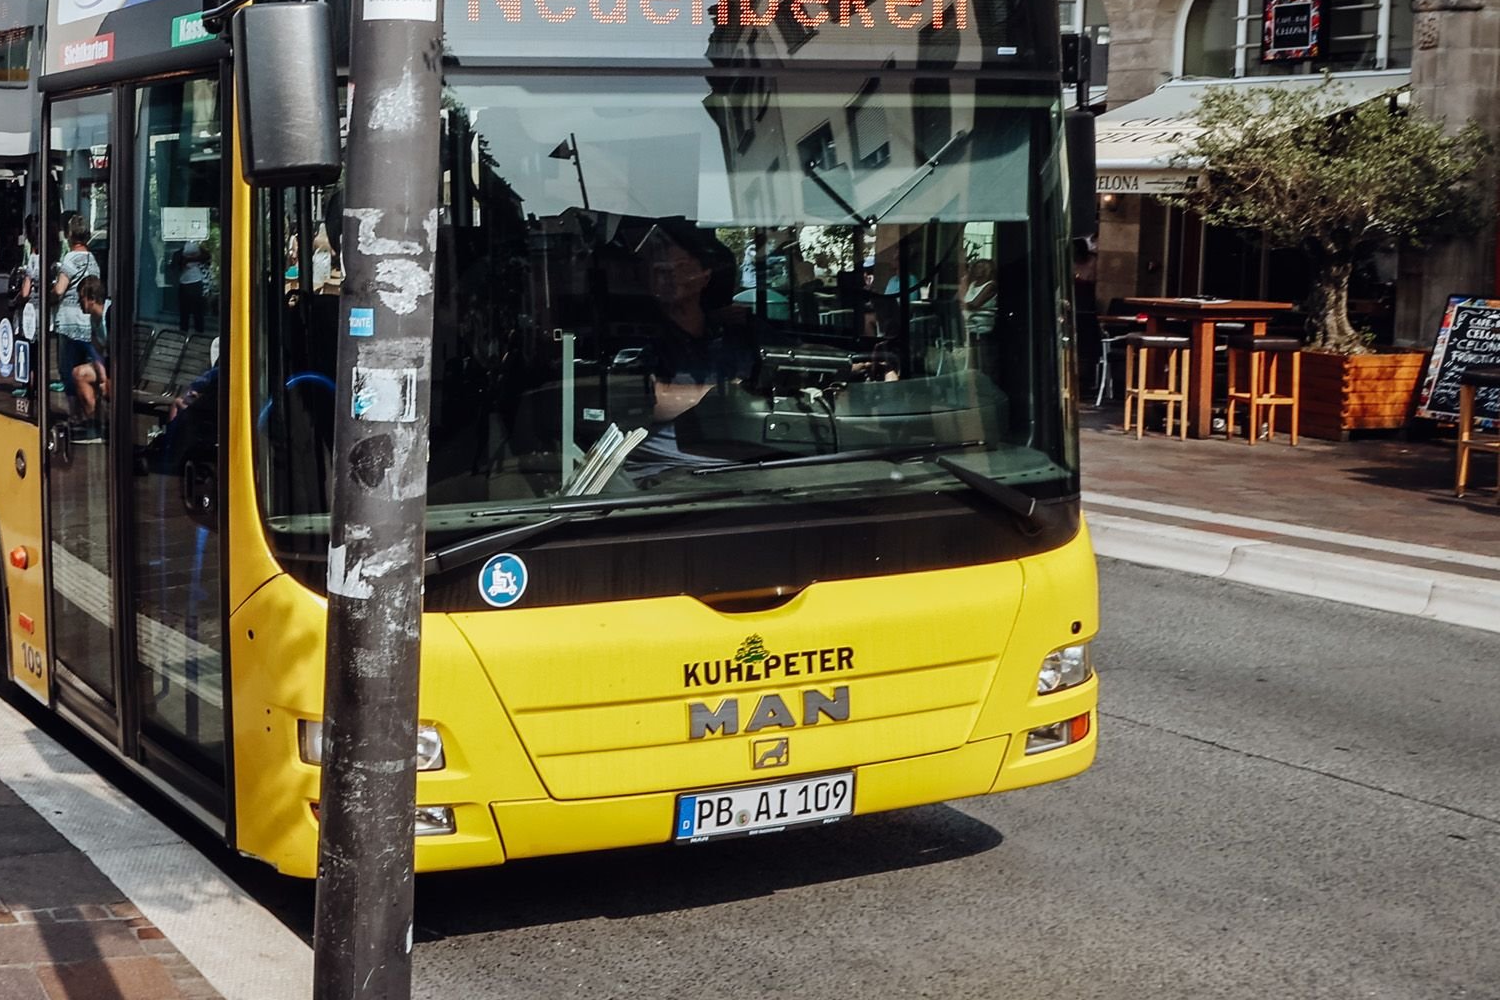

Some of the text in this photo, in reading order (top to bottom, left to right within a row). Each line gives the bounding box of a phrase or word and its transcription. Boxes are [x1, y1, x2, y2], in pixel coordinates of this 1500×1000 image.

[1095, 176, 1139, 191] ELONA
[15, 399, 30, 414] EEV
[21, 642, 42, 680] 109
[683, 646, 855, 688] KUHLPETER
[688, 685, 850, 740] MAN
[696, 779, 848, 830] PB AI 109
[682, 821, 690, 830] D
